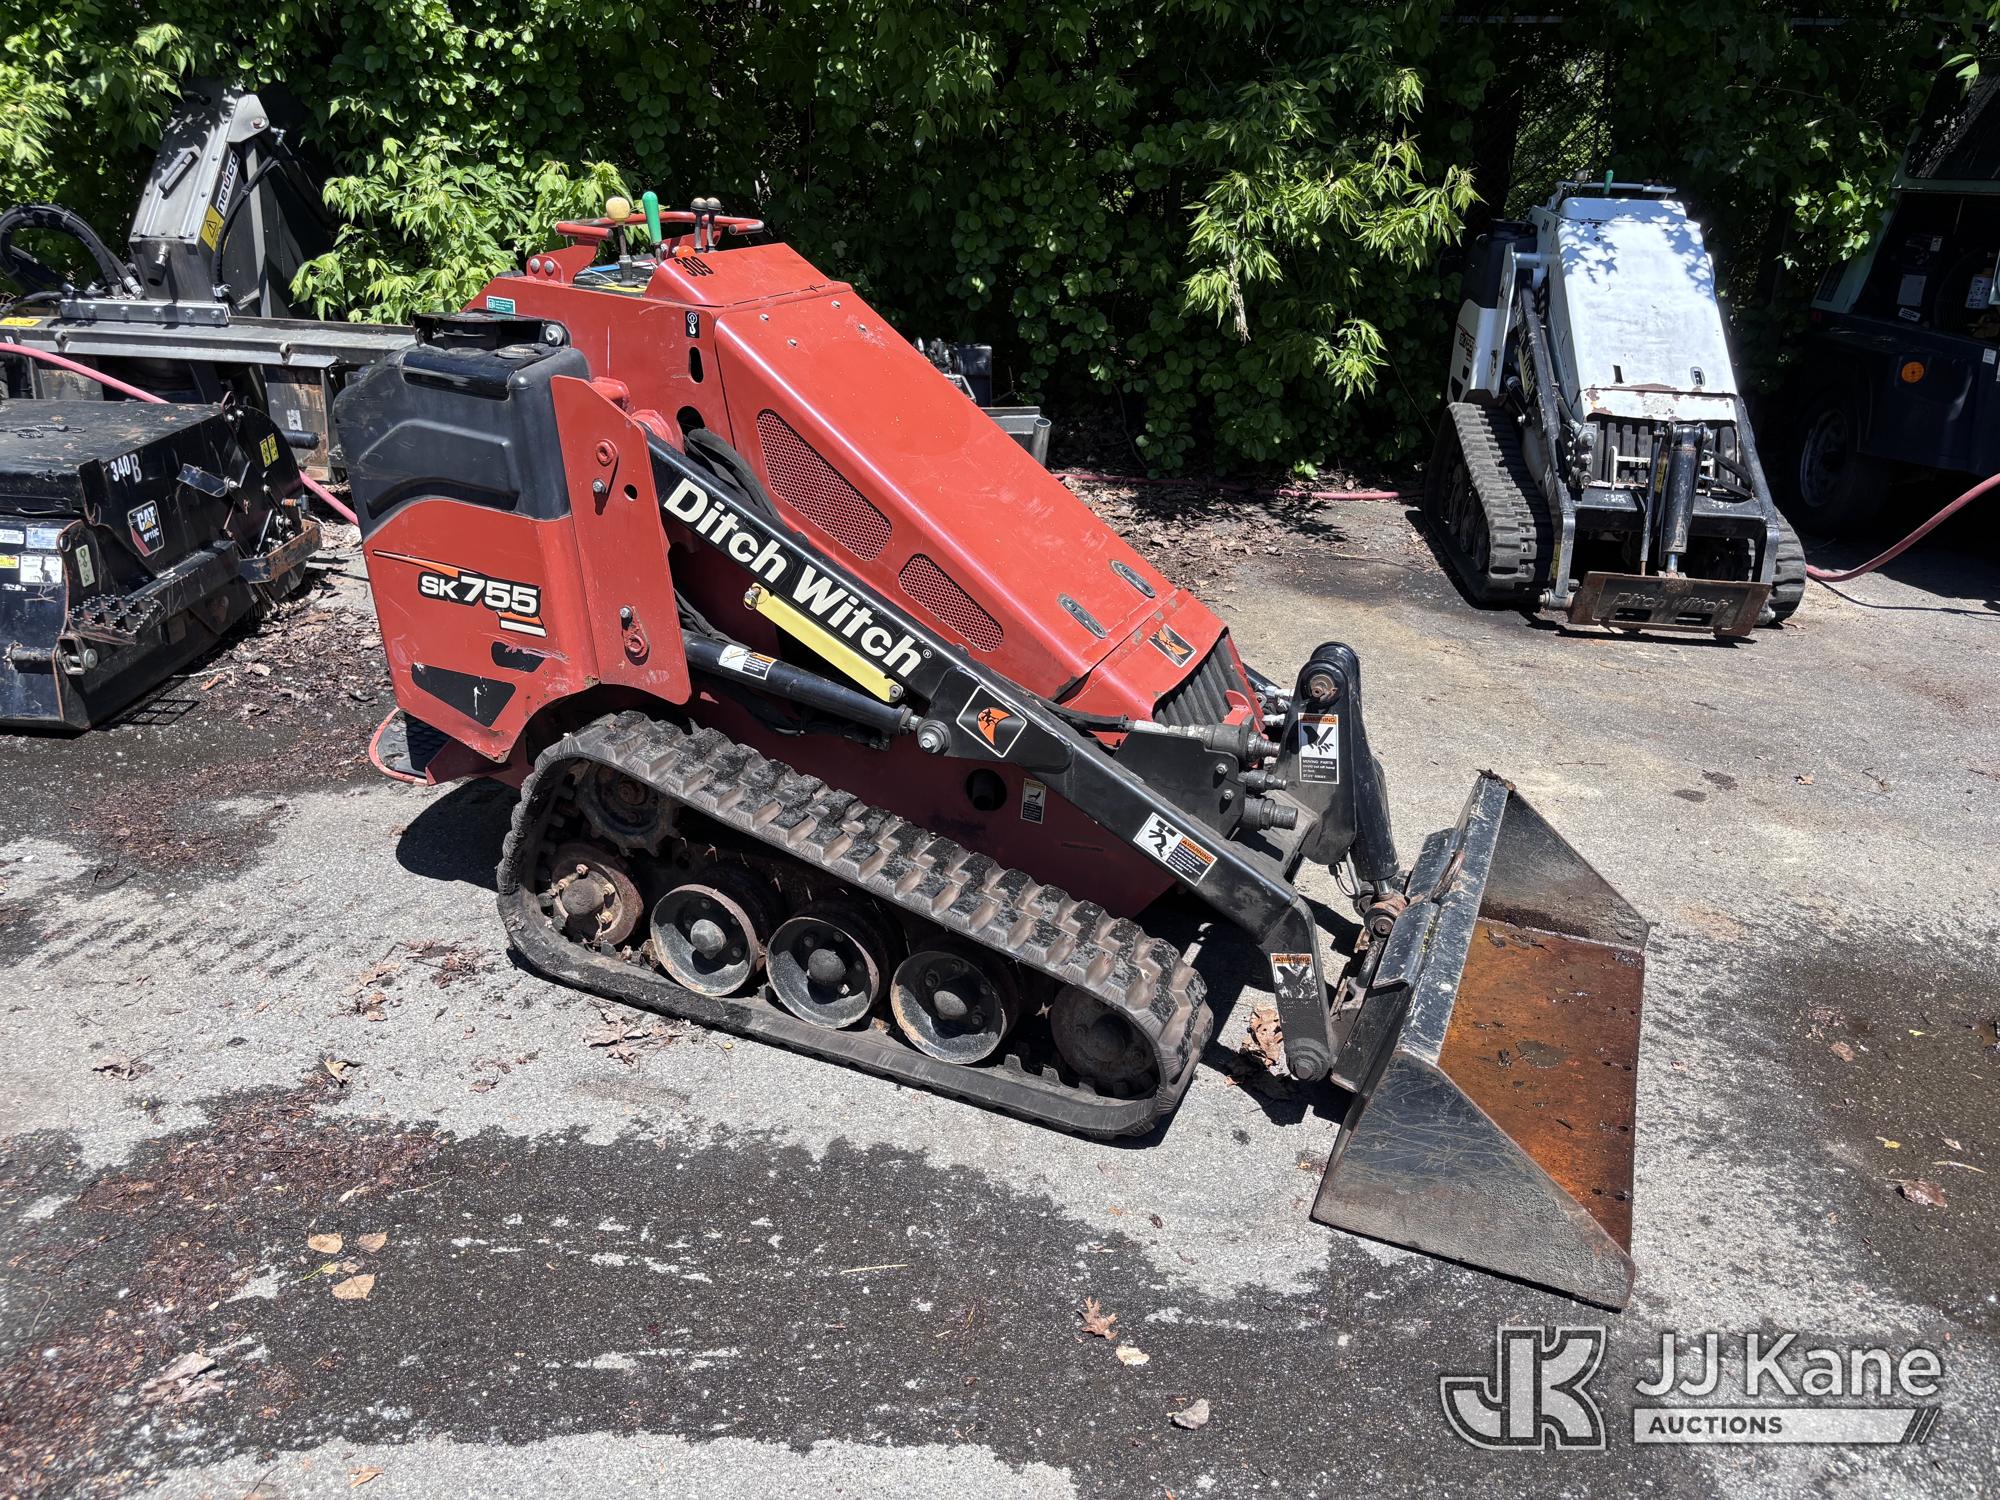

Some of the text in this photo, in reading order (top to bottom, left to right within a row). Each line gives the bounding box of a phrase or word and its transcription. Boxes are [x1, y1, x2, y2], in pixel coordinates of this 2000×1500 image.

[673, 256, 714, 277] 309
[136, 505, 157, 532] CAT
[663, 477, 788, 584] Ditch
[421, 575, 538, 614] SK755
[1187, 841, 1212, 863] WARNING
